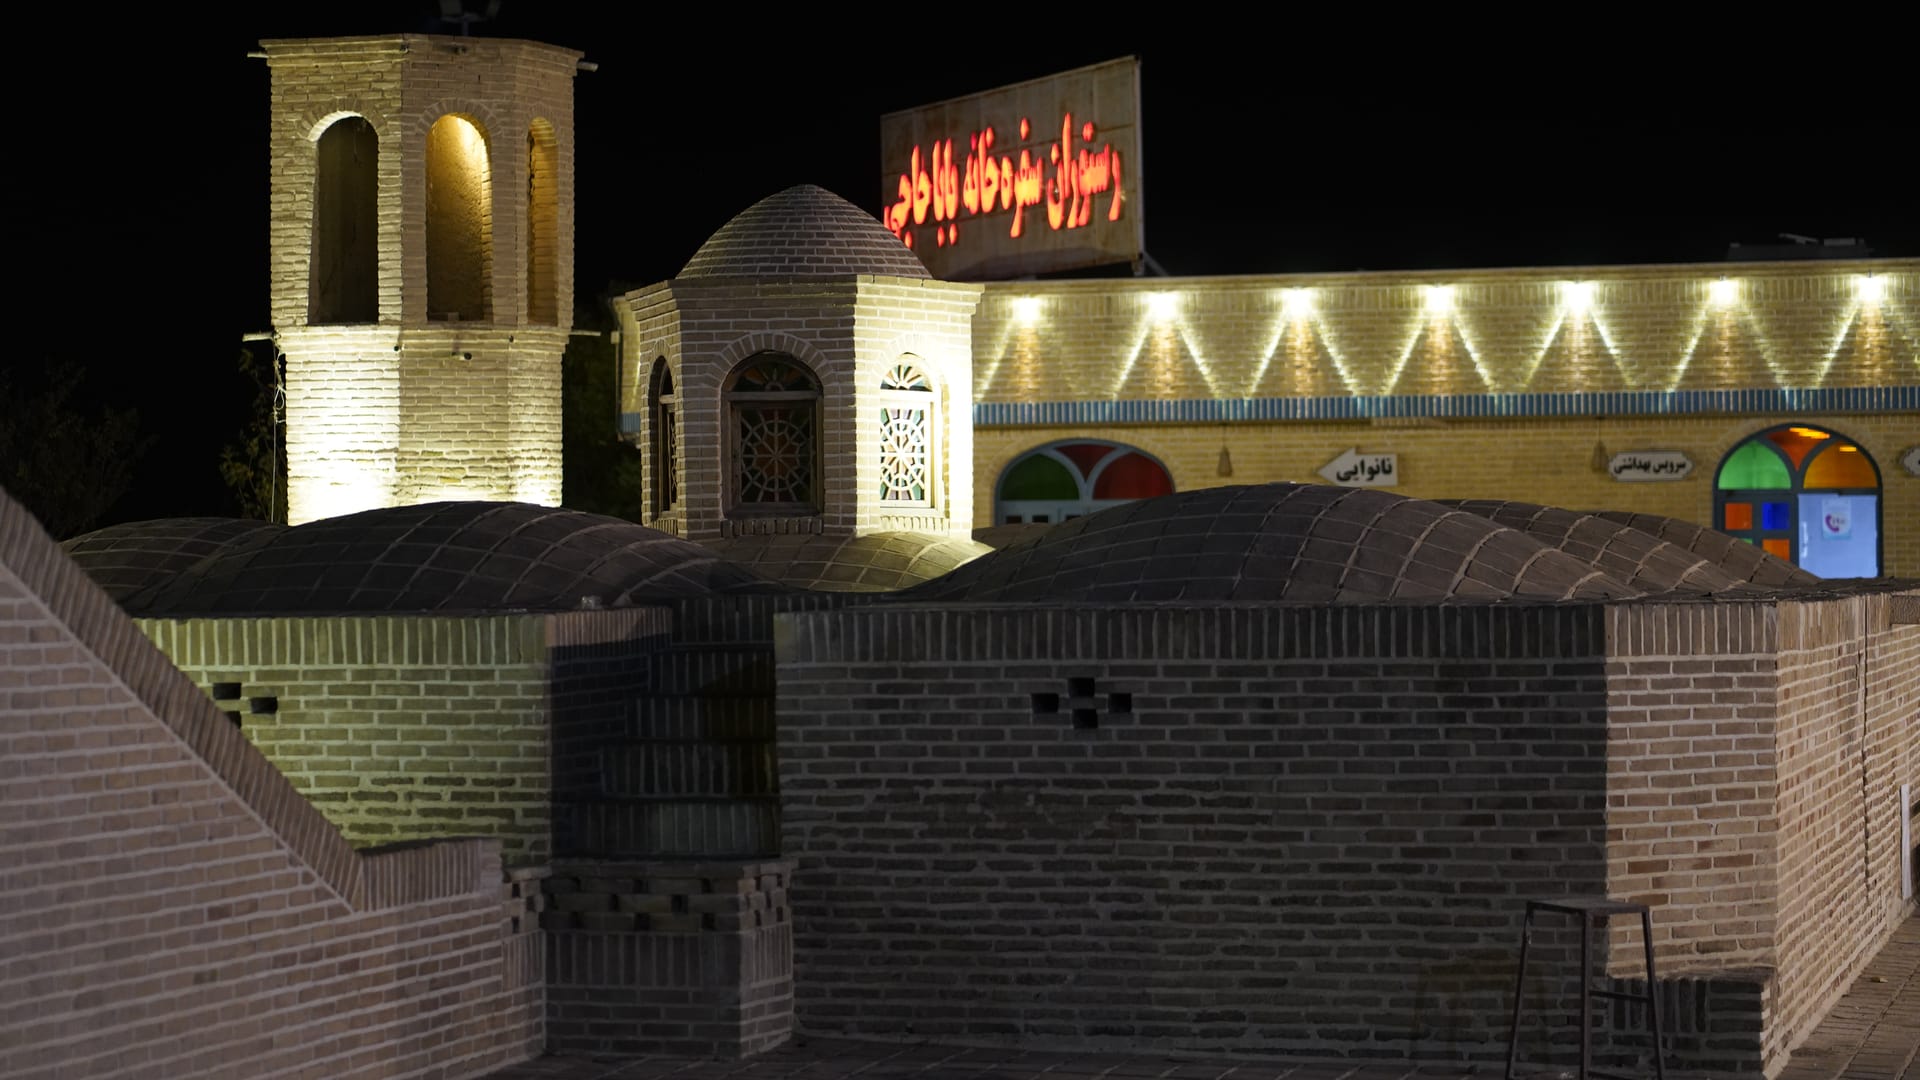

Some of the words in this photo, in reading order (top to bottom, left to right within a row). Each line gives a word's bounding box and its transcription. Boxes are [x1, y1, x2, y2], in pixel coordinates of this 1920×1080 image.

[1047, 112, 1121, 230] رستوران
[932, 138, 959, 248] بابا
[1336, 457, 1392, 482] نانوایی
[1614, 457, 1651, 474] بهداشتی
[1653, 461, 1686, 474] سرویس
